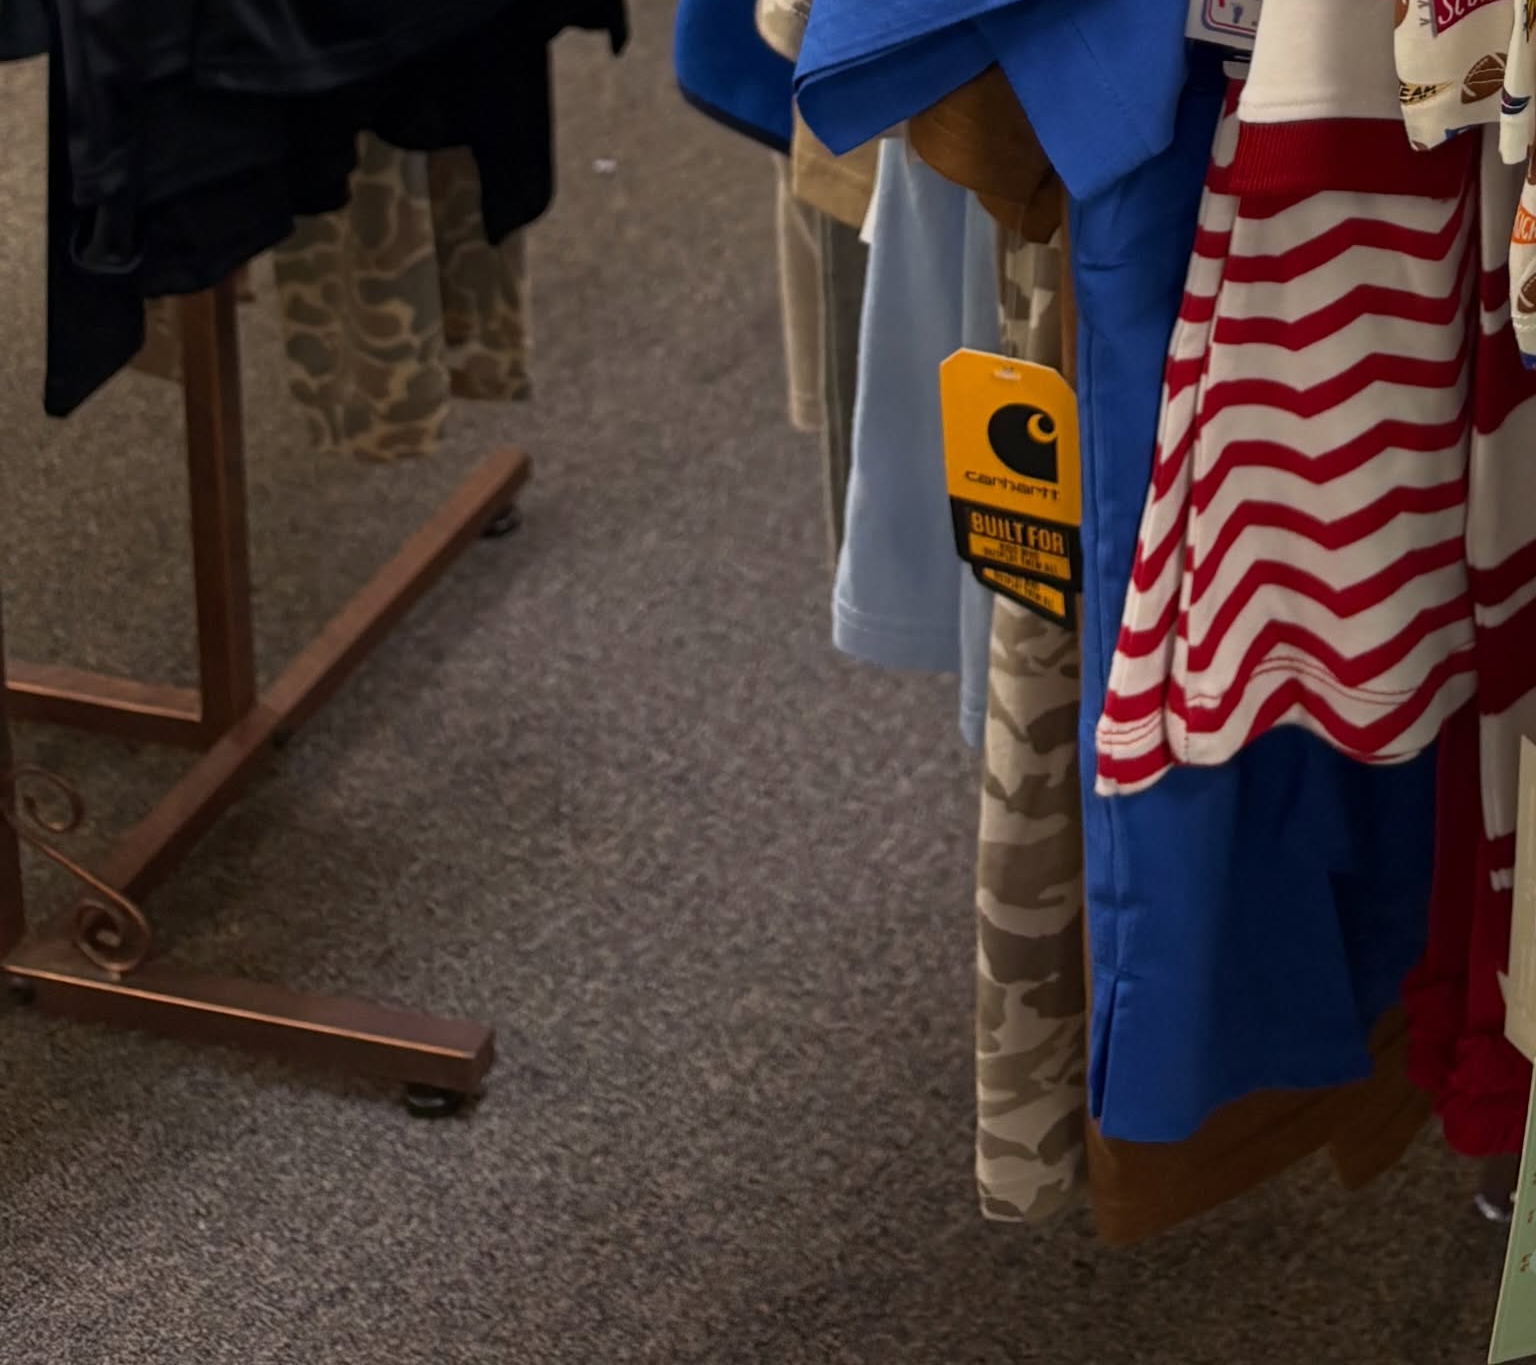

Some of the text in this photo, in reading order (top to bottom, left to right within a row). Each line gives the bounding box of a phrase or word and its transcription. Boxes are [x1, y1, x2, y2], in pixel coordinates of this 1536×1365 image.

[964, 470, 1060, 502] carhartt
[970, 511, 1064, 555] BUILT FOR
